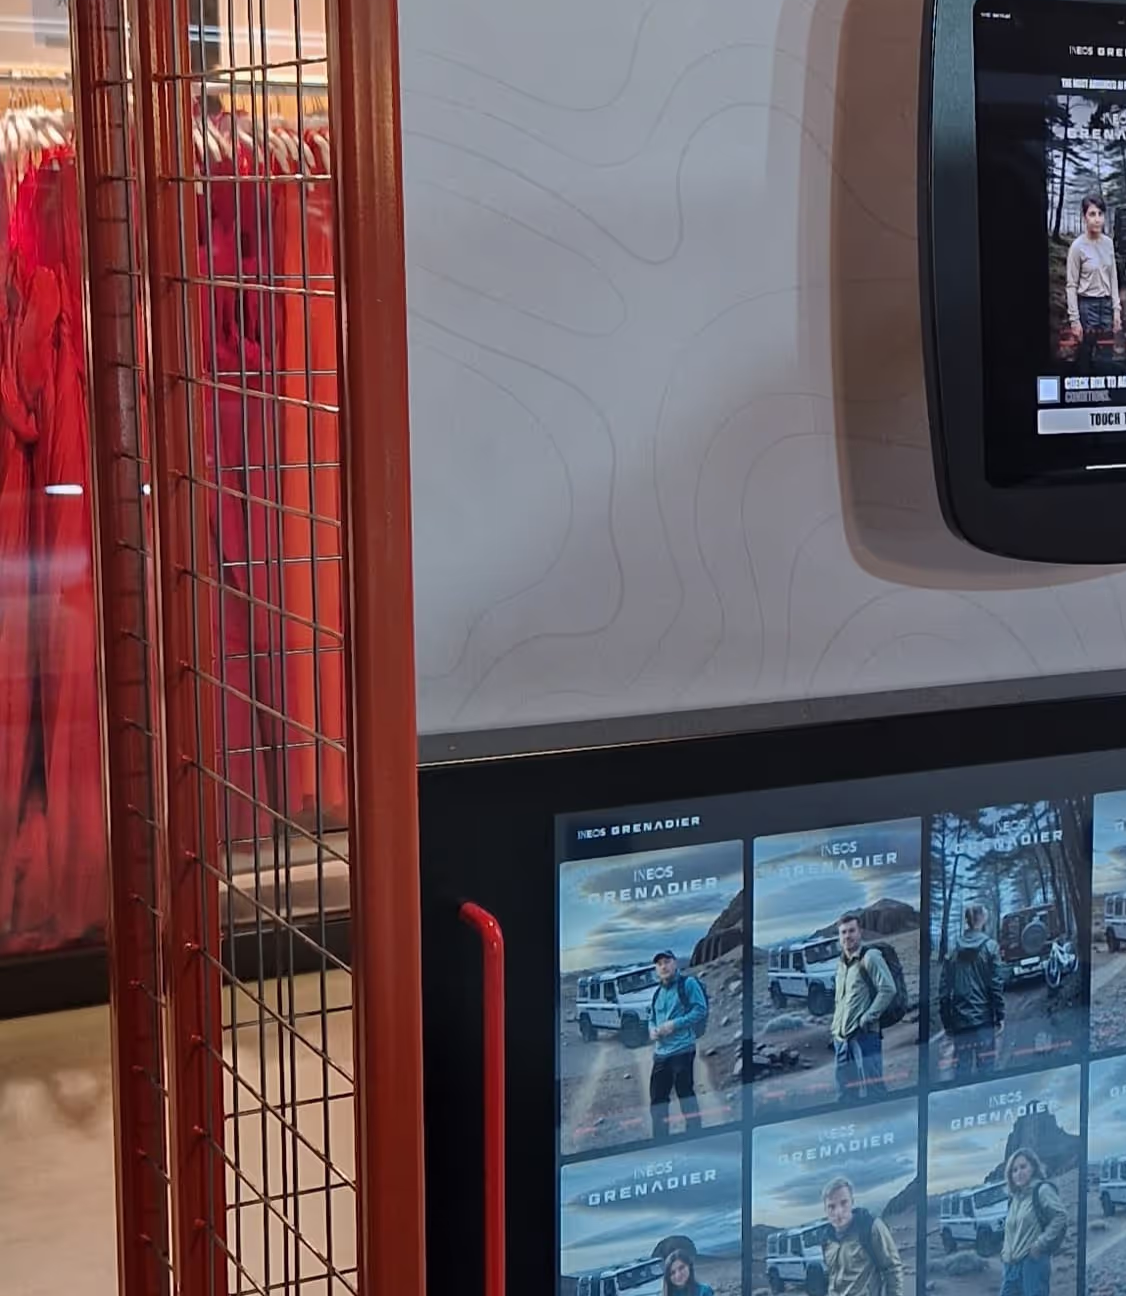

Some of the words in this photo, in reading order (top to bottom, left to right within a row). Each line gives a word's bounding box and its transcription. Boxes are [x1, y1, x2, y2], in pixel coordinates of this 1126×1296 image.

[1069, 45, 1094, 56] INEOS
[1107, 376, 1116, 388] TO
[1090, 412, 1120, 426] TOUCH
[577, 826, 606, 840] INEOS
[611, 816, 700, 836] GRENADIER
[821, 841, 857, 856] INEOS
[634, 865, 673, 882] INEOS
[588, 877, 717, 904] GRENADIER
[778, 1132, 894, 1164] GRENADIER
[634, 1161, 673, 1180] INEOS
[588, 1168, 717, 1206] GRENADIER
